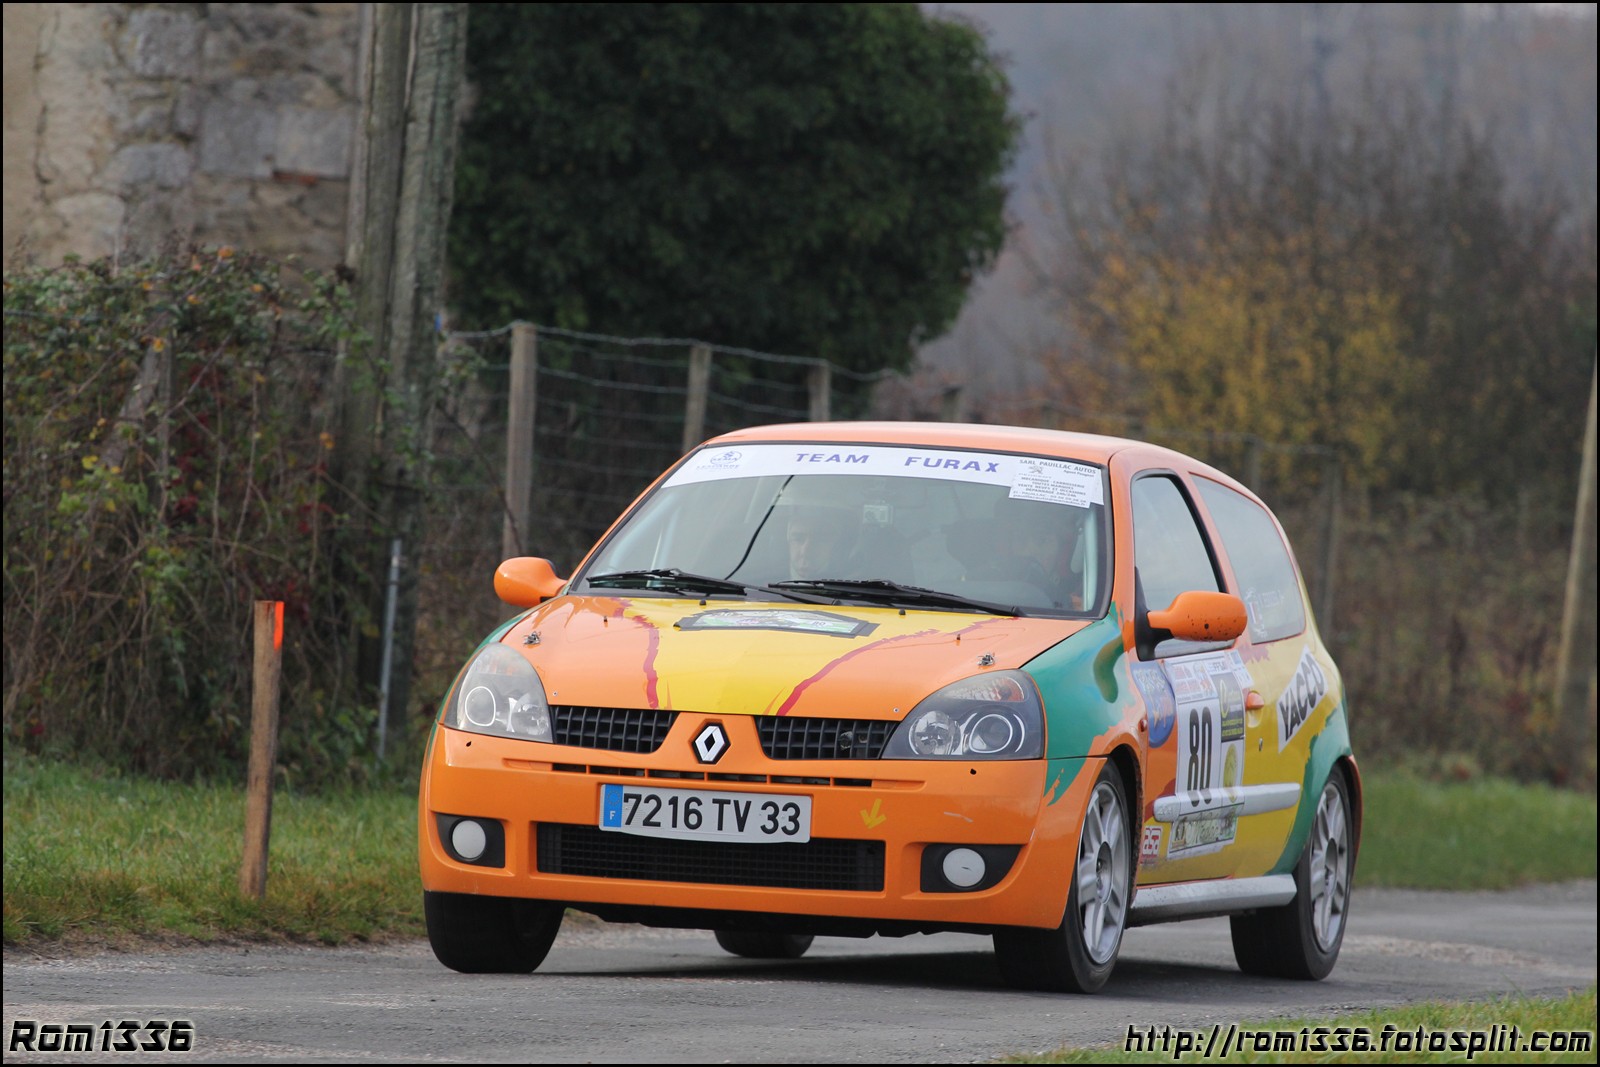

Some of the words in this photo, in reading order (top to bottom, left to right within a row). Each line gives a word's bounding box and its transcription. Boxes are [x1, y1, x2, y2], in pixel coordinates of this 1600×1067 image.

[796, 453, 870, 464] TEAM
[904, 456, 1000, 473] FURAX
[1039, 461, 1071, 470] PAUILLAC
[1074, 465, 1096, 475] AUTOS
[1279, 653, 1325, 742] YACCO
[1187, 706, 1212, 807] 80
[609, 811, 616, 820] F
[623, 793, 703, 830] 7216
[712, 798, 752, 832] TV
[760, 801, 800, 836] 33
